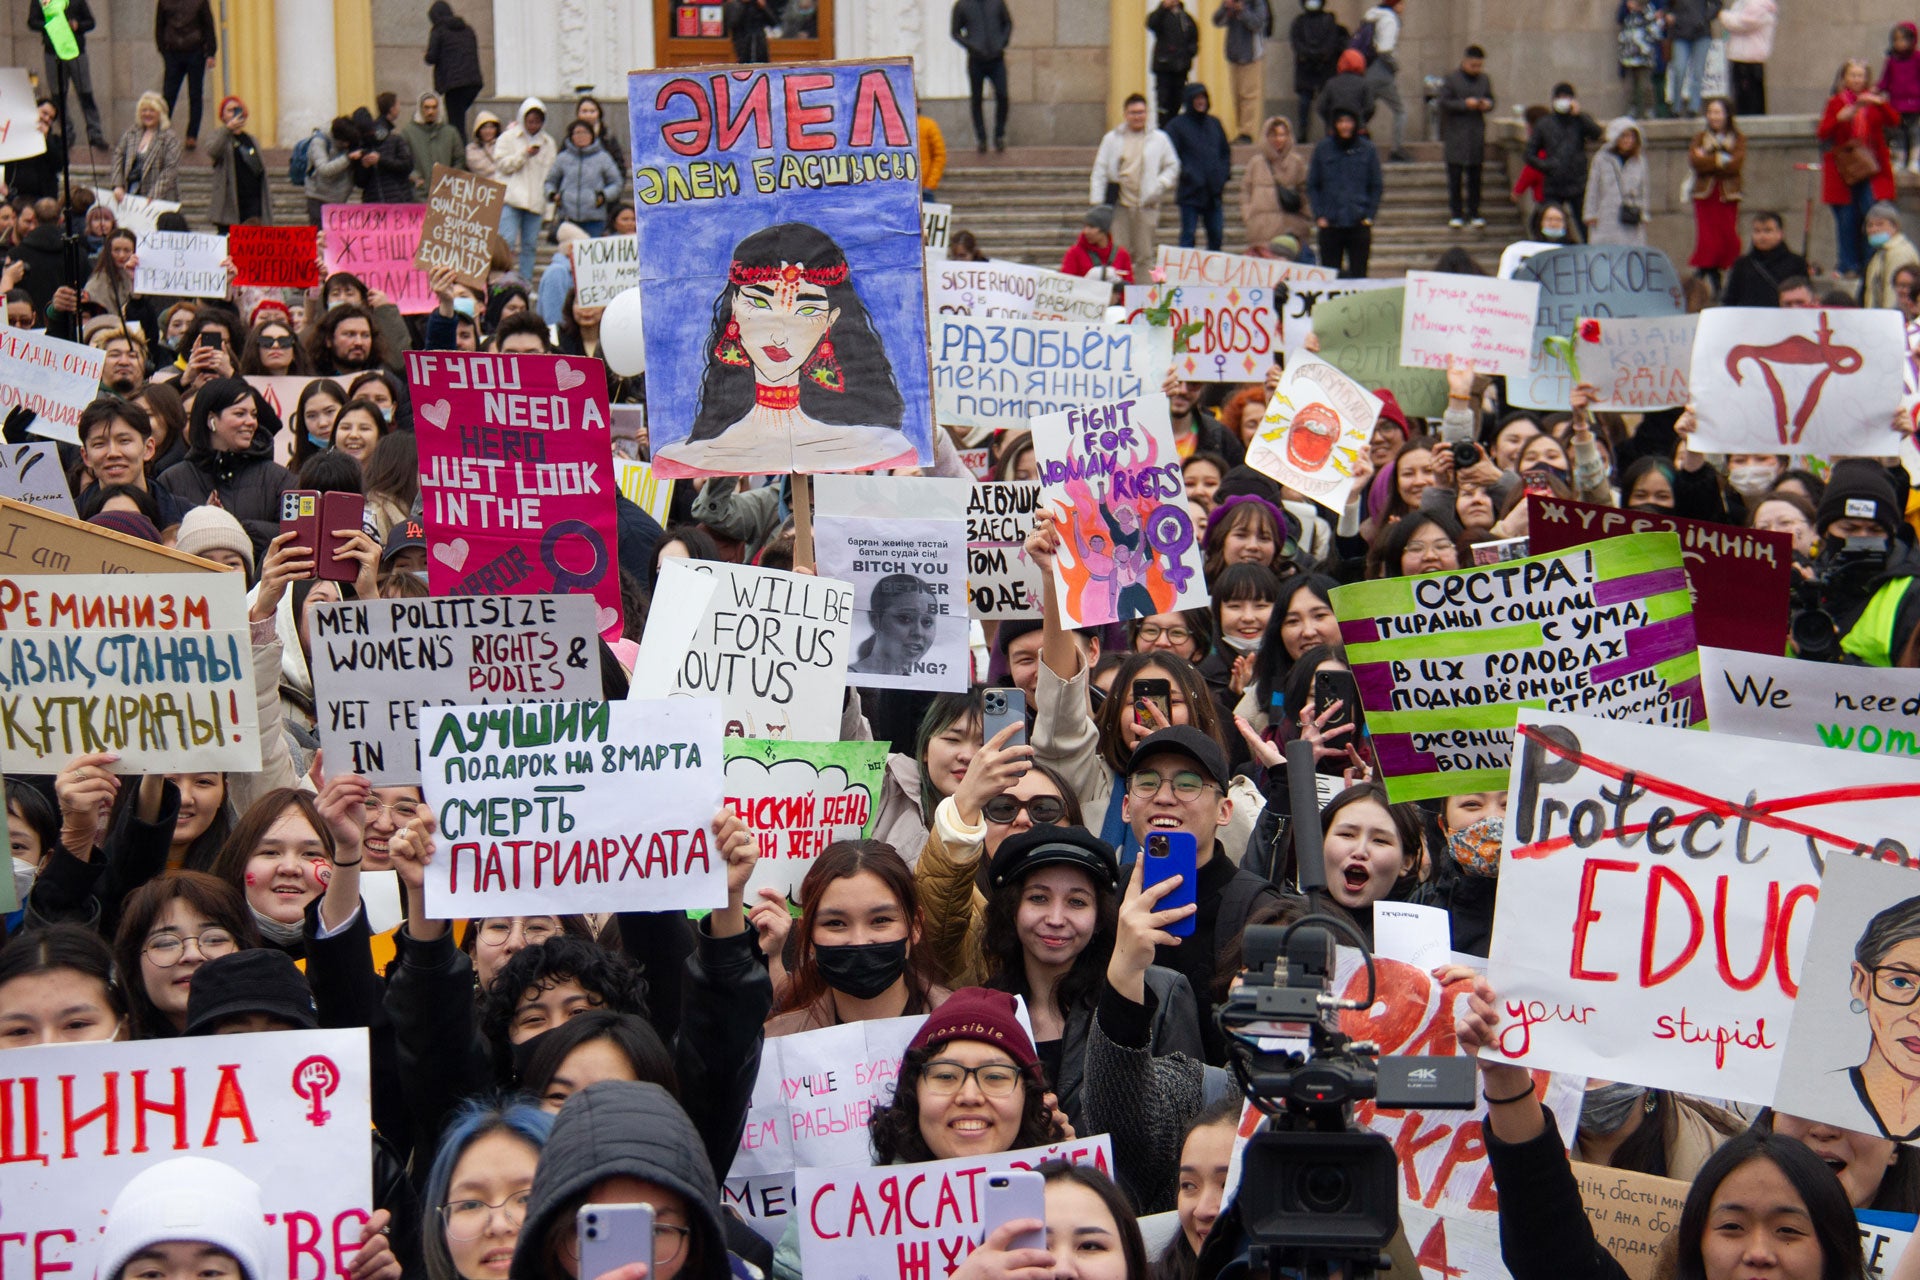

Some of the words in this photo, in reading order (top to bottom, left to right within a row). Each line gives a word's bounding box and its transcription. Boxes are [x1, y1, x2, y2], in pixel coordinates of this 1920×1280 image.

[655, 69, 912, 156] ӘЙЕЛ
[433, 174, 476, 203] MEN
[477, 185, 498, 207] OF
[636, 161, 741, 205] ӘЛЕМ
[430, 196, 480, 221] QUALITY
[432, 225, 492, 260] GENDER
[443, 215, 493, 241] SUPPORT
[418, 240, 490, 279] EQUALITY
[941, 270, 1036, 300] SISTERHOOD
[409, 353, 437, 386] IF
[445, 356, 521, 390] YOU
[483, 392, 570, 431] NEED
[581, 397, 605, 431] A
[460, 424, 546, 463] HERO
[1083, 427, 1139, 455] FOR
[420, 455, 505, 493] JUST
[515, 461, 602, 496] LOOK
[1036, 450, 1118, 488] WOMAN
[1, 523, 26, 559] I
[32, 546, 71, 572] am
[891, 549, 919, 558] судай
[852, 560, 906, 573] BITCH
[911, 562, 948, 575] YOU
[317, 605, 369, 636] MEN
[391, 597, 557, 633] POLITISIZE
[731, 572, 819, 619] WILL
[824, 588, 853, 625] BE
[927, 603, 950, 615] BE
[328, 635, 453, 672] WOMEN'S
[472, 631, 559, 665] RIGHTS
[566, 636, 589, 670] &
[714, 612, 786, 655] FOR
[795, 625, 835, 667] US
[469, 661, 565, 693] BODIES
[751, 656, 798, 704] US
[1392, 660, 1412, 683] В
[1723, 667, 1793, 709] We
[328, 700, 370, 732] YET
[429, 700, 610, 757] ЛУЧШИЙ
[350, 741, 384, 774] IN
[444, 753, 558, 784] ПОДАРОК
[565, 750, 594, 774] НА
[819, 793, 868, 827] ДЕНЬ
[1515, 724, 1770, 865] Protect
[440, 796, 575, 840] СМЕРТЬ
[450, 827, 710, 894] ПАТРИАРХАТА
[926, 1022, 1004, 1044] possible
[1498, 999, 1598, 1059] your
[1652, 1006, 1777, 1070] stupid
[1408, 1068, 1437, 1079] 4K
[810, 1166, 987, 1240] САЯСАТ
